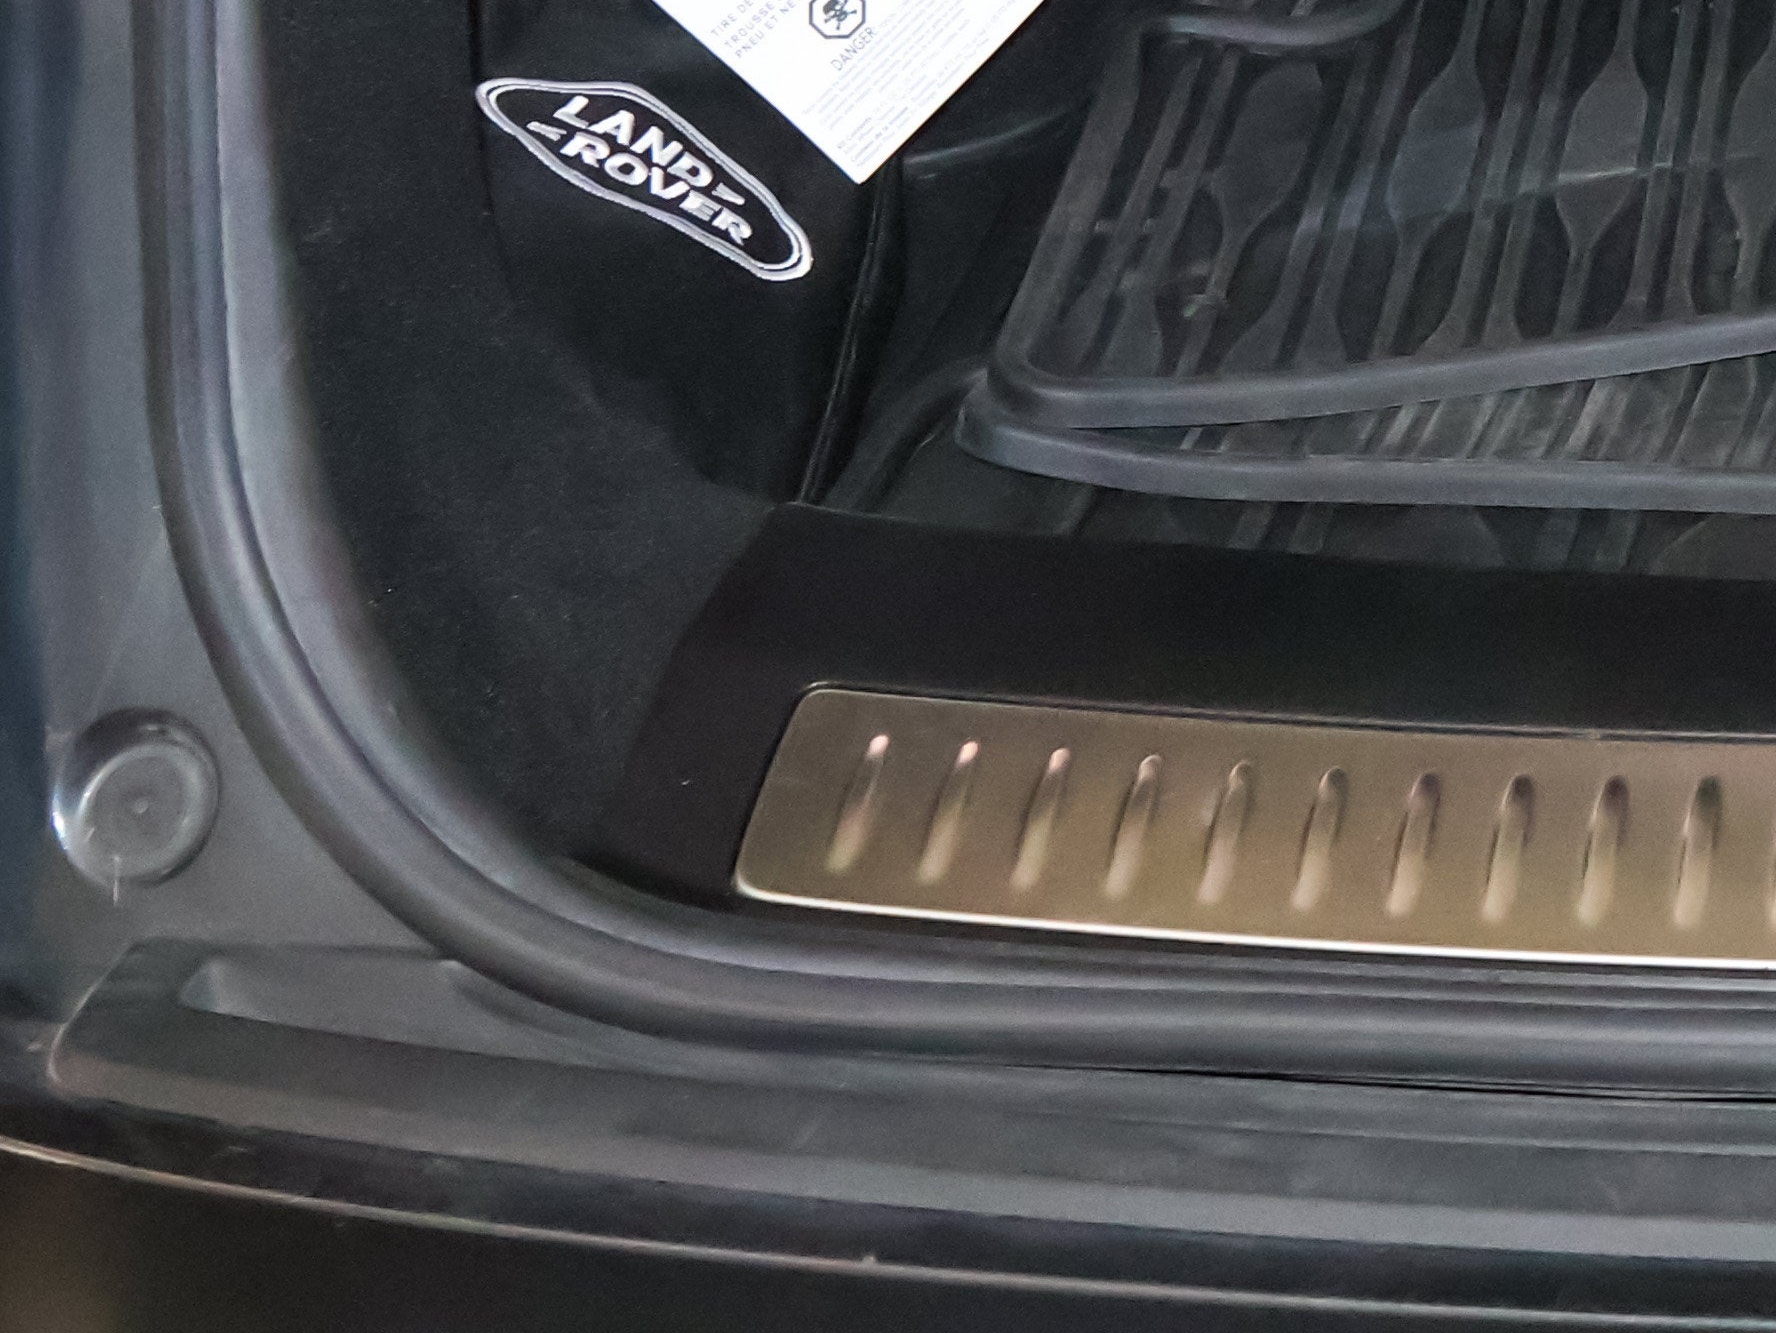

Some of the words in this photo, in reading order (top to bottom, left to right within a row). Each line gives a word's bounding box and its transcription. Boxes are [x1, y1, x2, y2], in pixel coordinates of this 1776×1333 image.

[711, 13, 736, 38] TIRE
[724, 1, 774, 49] TROUSSE
[734, 29, 764, 57] PNEU
[764, 15, 779, 29] ET
[830, 26, 876, 70] DANGER
[553, 95, 712, 189] LAND
[560, 135, 753, 245] ROVER
